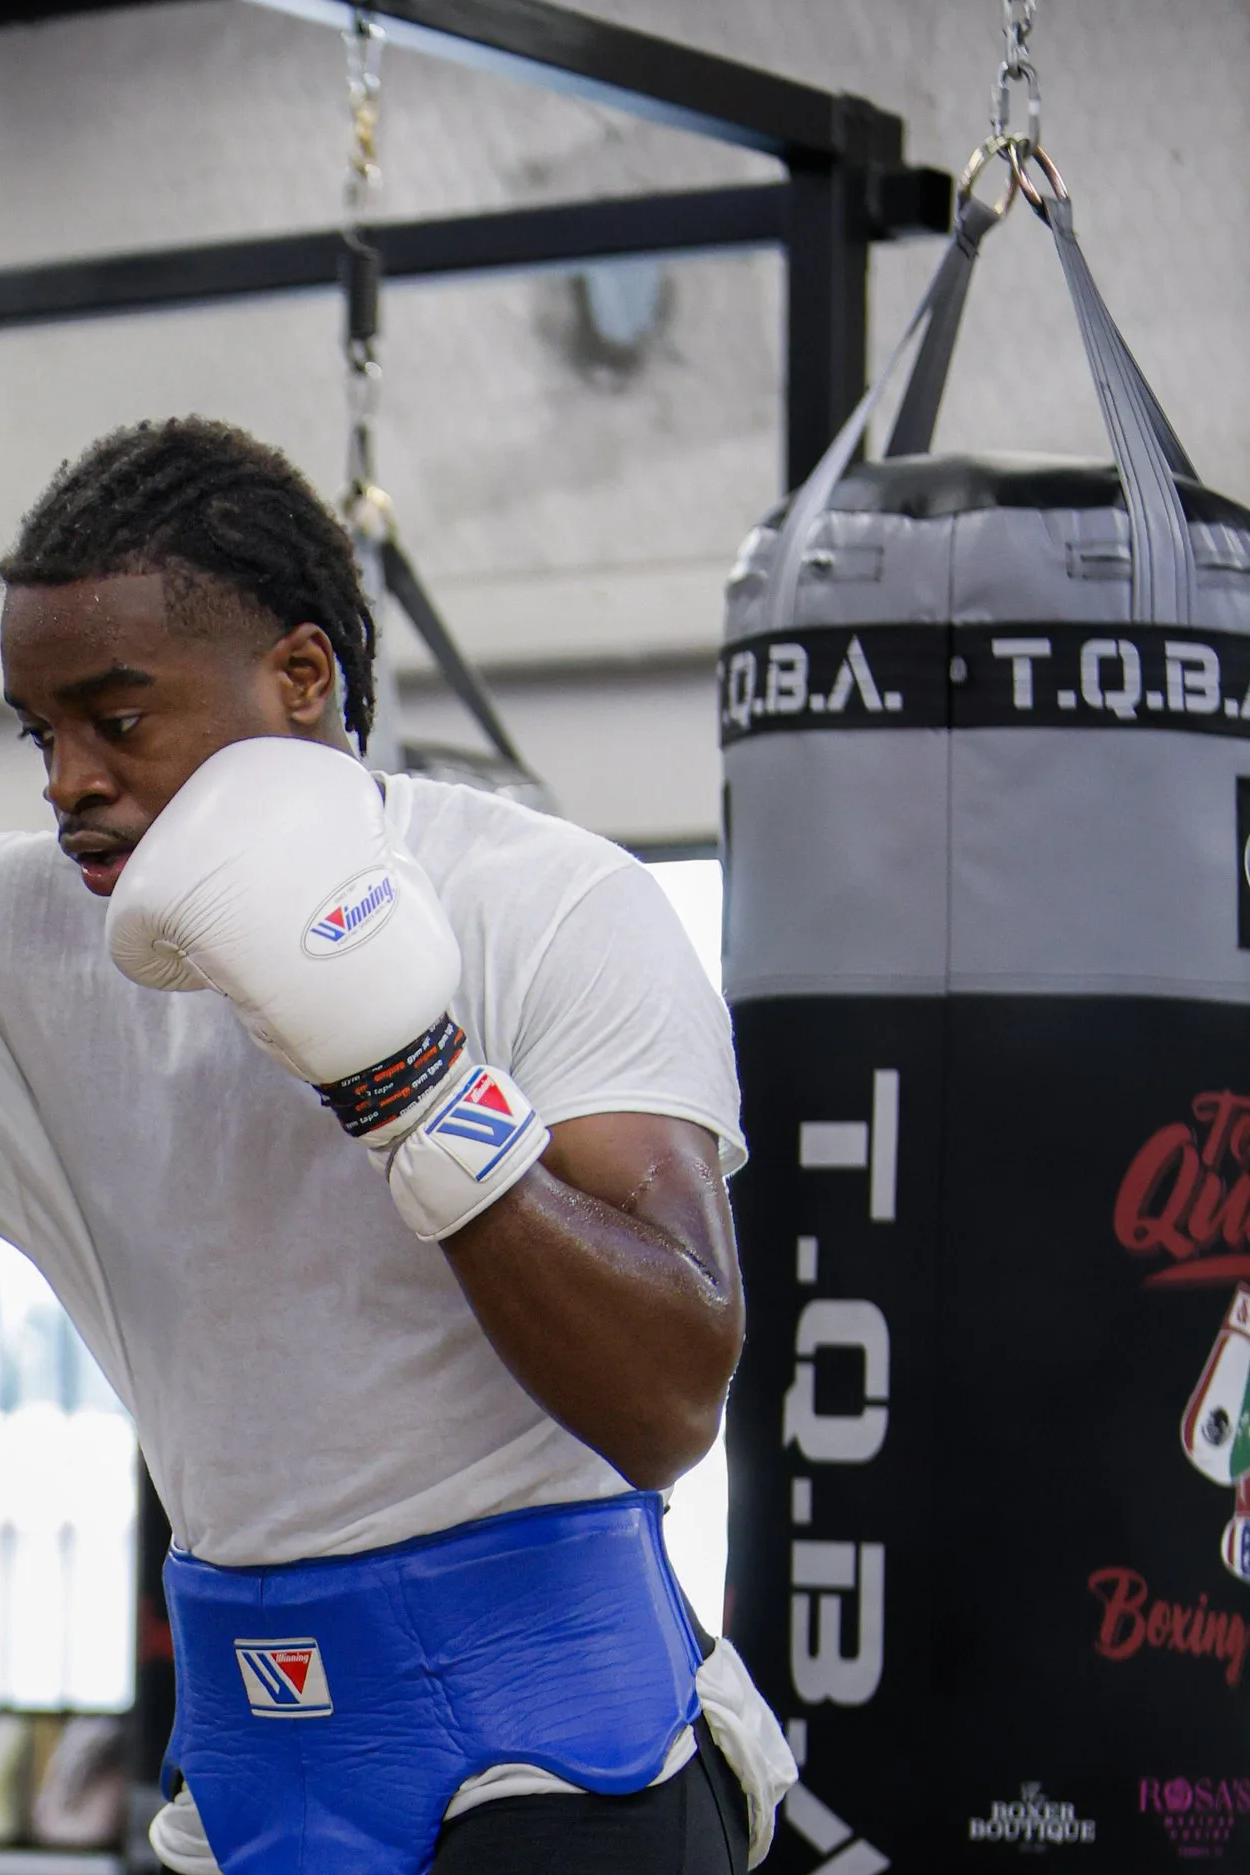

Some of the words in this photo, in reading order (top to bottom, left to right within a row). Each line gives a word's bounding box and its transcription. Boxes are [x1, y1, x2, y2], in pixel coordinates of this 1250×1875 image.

[992, 637, 1250, 720] T.Q.B.
[310, 876, 395, 942] Winning
[1087, 1566, 1248, 1689] Boxing
[969, 1817, 1096, 1842] BOUTIQUE
